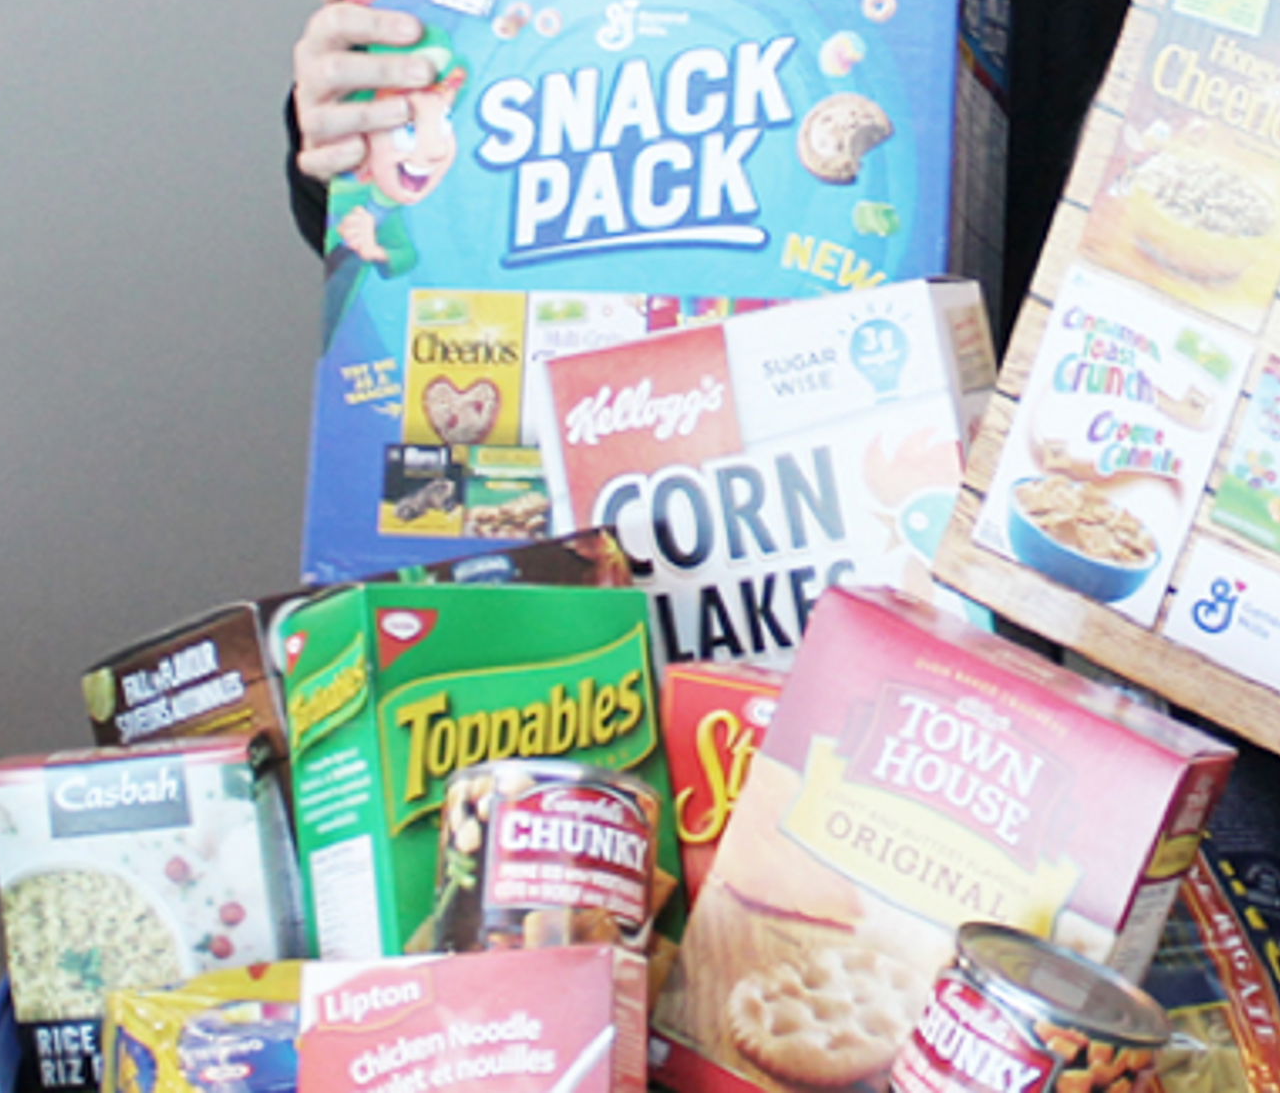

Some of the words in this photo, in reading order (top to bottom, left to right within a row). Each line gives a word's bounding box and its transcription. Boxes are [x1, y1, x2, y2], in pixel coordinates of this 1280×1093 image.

[477, 37, 797, 165] SNACK
[515, 128, 766, 245] PACK
[412, 330, 519, 366] Cheerios
[763, 347, 839, 380] SUGAR
[1053, 352, 1155, 405] Crunch
[565, 377, 724, 445] Kellogg's
[772, 370, 834, 396] WISE
[602, 445, 846, 577] CORN
[395, 669, 643, 803] Toppables
[898, 694, 1045, 798] TOWN
[53, 763, 181, 815] Casbah
[870, 735, 1032, 846] HOUSE
[500, 810, 649, 873] CHUNKY
[824, 809, 1009, 924] ORIGINAL
[324, 980, 421, 1023] Lipton
[35, 1025, 97, 1055] RICE
[349, 1032, 446, 1085] Chicken
[446, 1010, 542, 1047] Noodle
[430, 1061, 455, 1085] et
[455, 1042, 558, 1080] nouilles
[40, 1057, 86, 1087] RIZ
